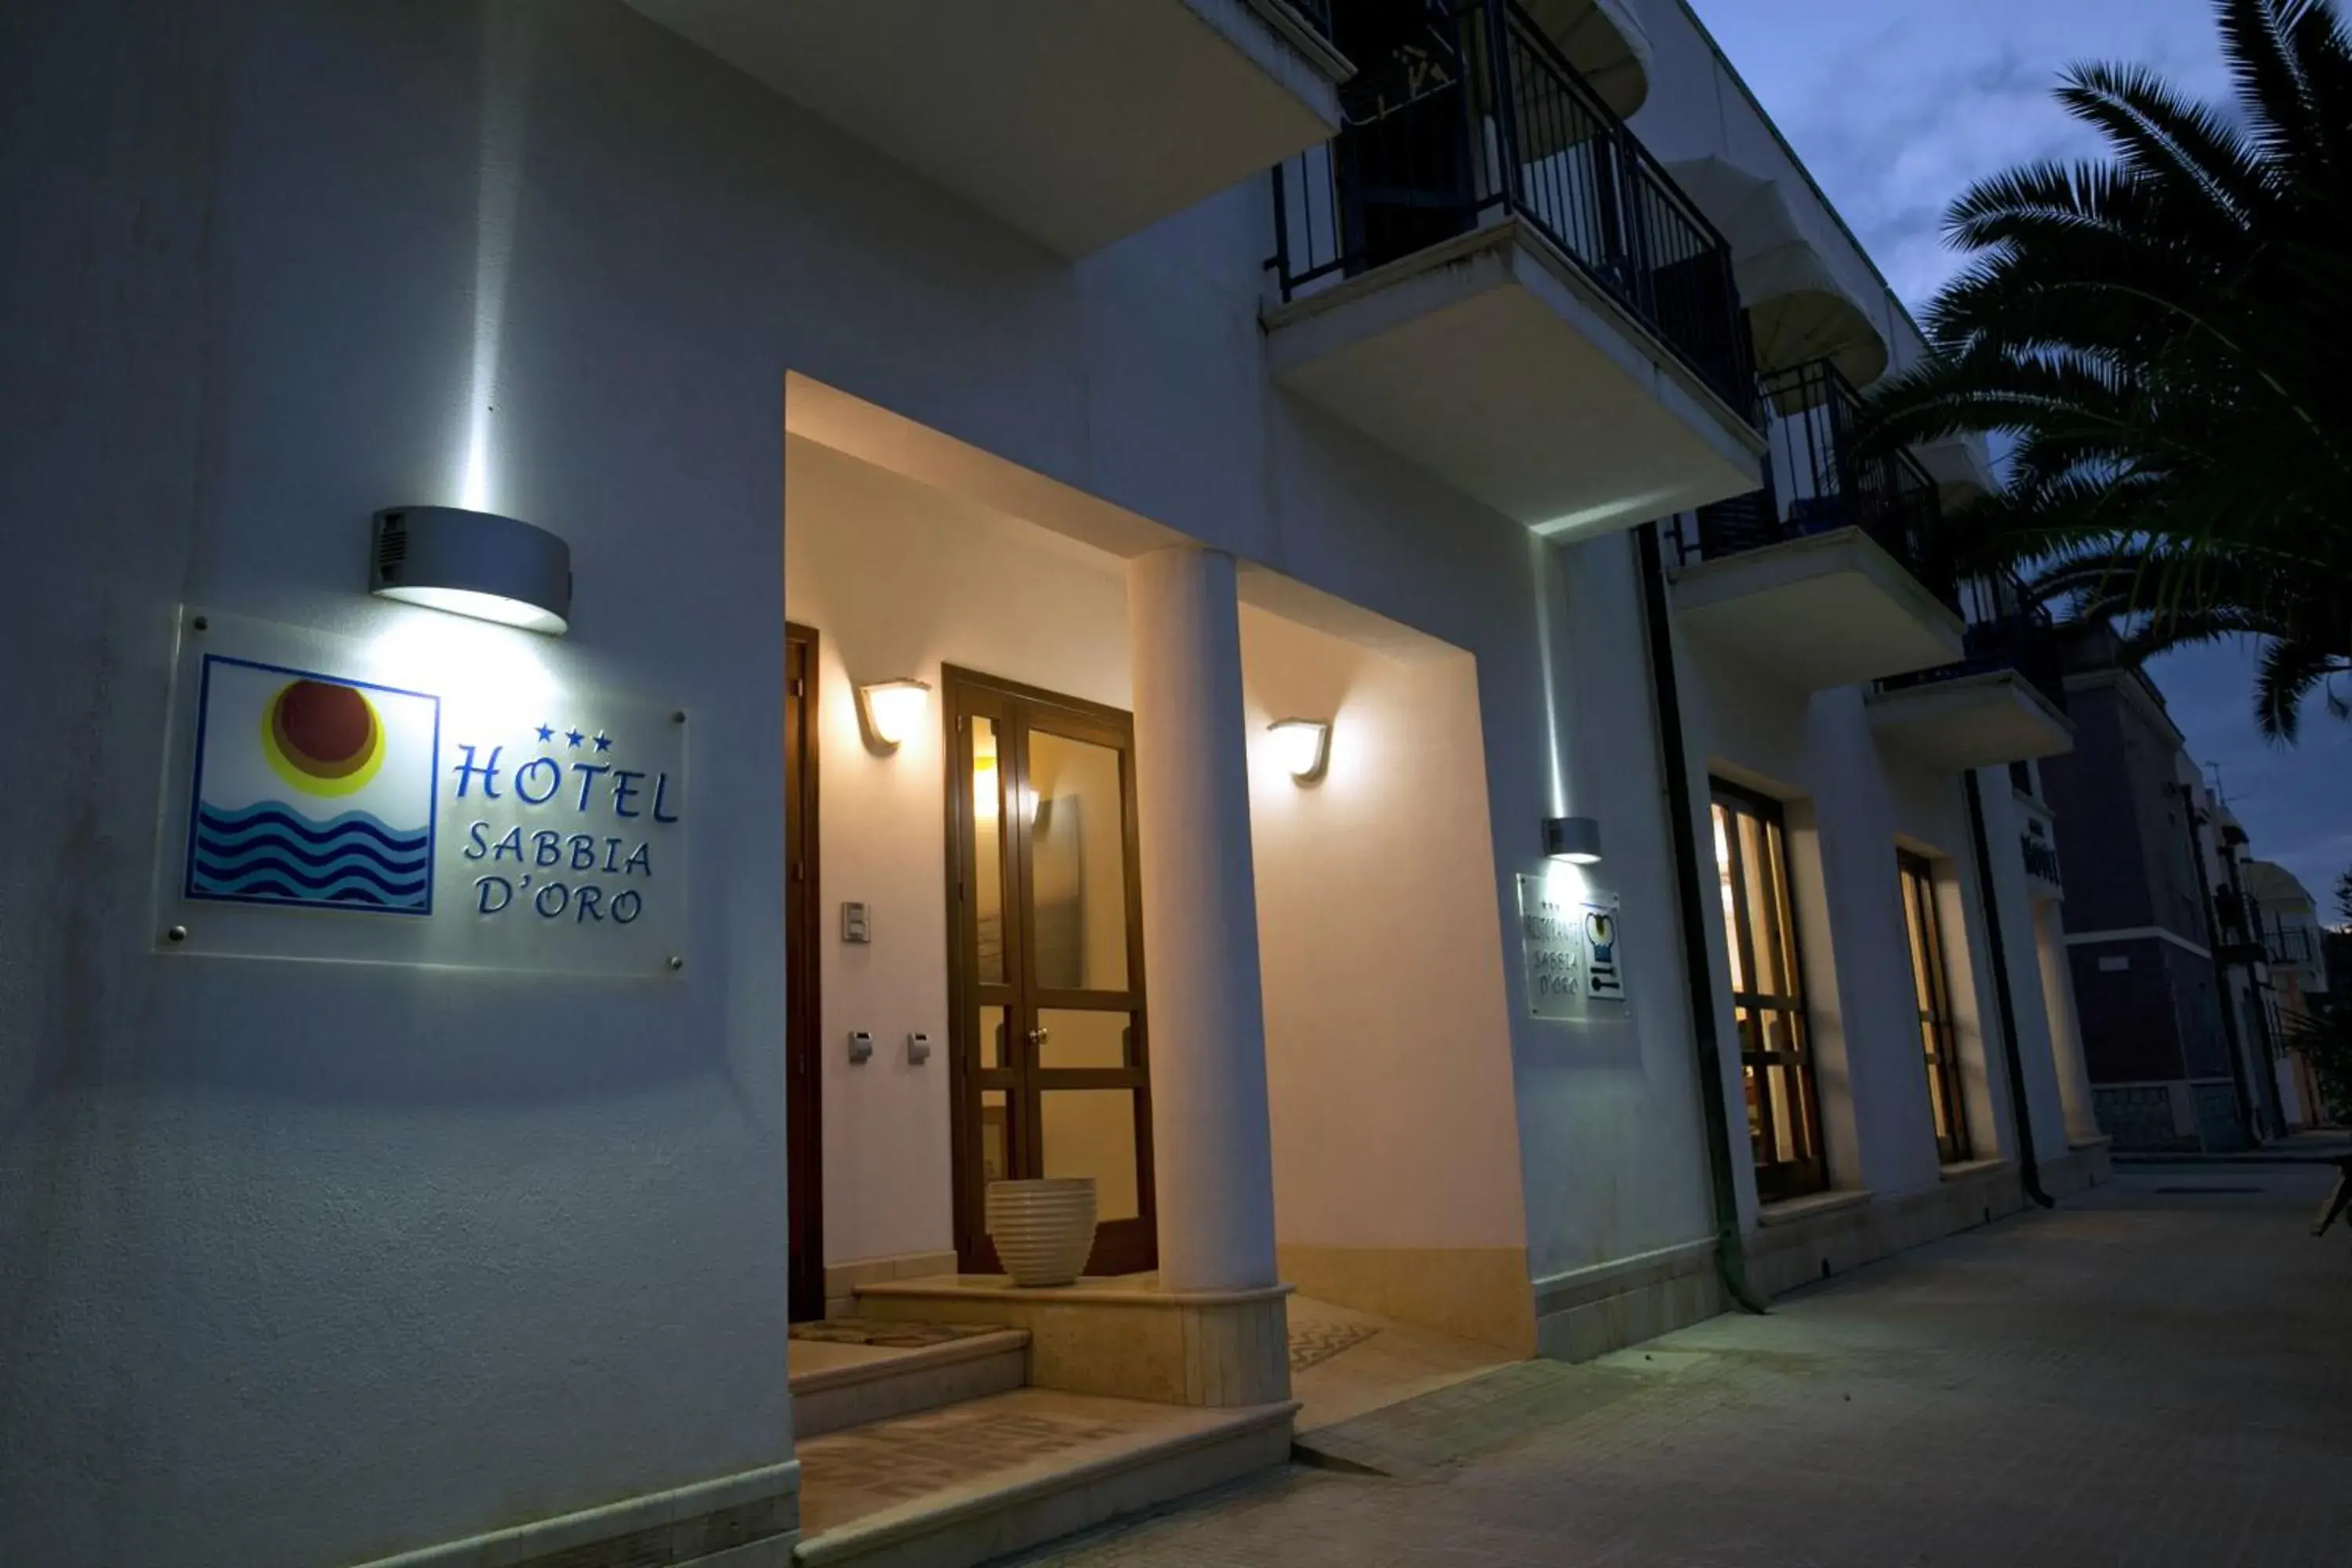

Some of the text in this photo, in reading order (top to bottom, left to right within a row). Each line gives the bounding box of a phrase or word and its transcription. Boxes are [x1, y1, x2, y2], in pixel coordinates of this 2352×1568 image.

[455, 744, 678, 823] HOTEL
[463, 822, 652, 877] SABBIA
[474, 875, 642, 924] D'ORO
